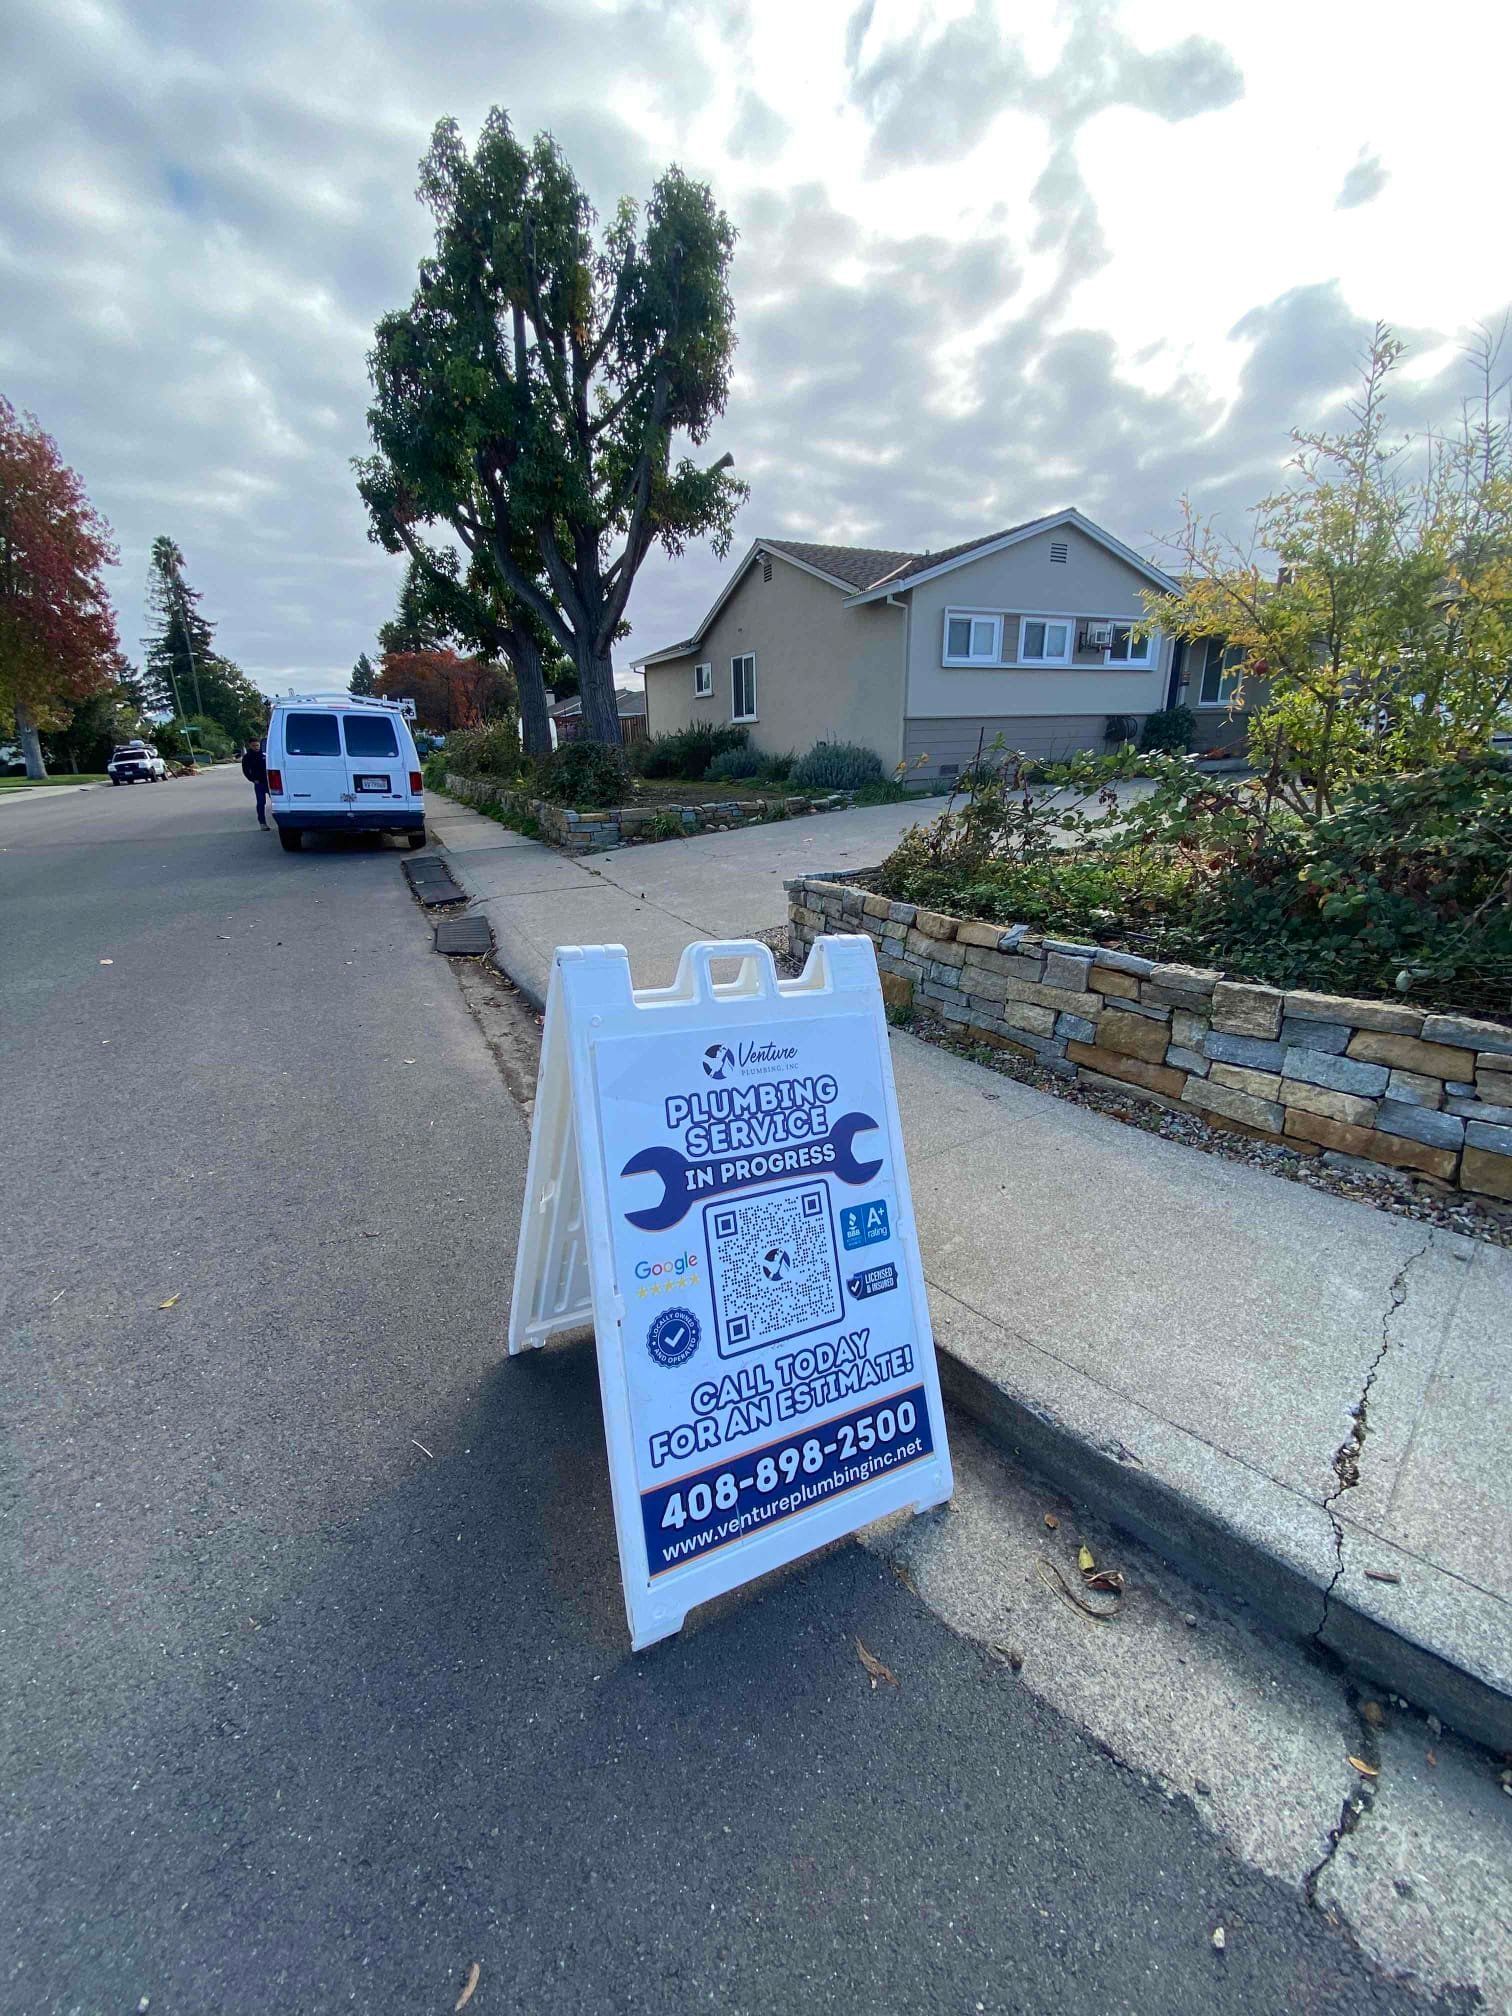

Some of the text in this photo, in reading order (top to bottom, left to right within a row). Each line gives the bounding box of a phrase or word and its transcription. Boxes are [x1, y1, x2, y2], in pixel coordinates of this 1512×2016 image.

[739, 1041, 798, 1067] Venture
[666, 1074, 838, 1128] PLUMBING
[685, 1106, 827, 1157] SERVICE
[685, 1143, 835, 1191] IN PROGRESS
[867, 1207, 885, 1228] A+
[867, 1226, 887, 1238] rating
[635, 1251, 698, 1279] Google
[865, 1267, 892, 1283] LICENSED
[652, 1312, 695, 1338] LOCALLY OWNED
[654, 1338, 696, 1363] AND OPERATED
[691, 1328, 870, 1415] CALL TODAY
[650, 1344, 913, 1468] FOR AN ESTIMATE!
[661, 1401, 916, 1530] 408-898-2500
[662, 1437, 923, 1562] www.ventureplumbinginc.net
